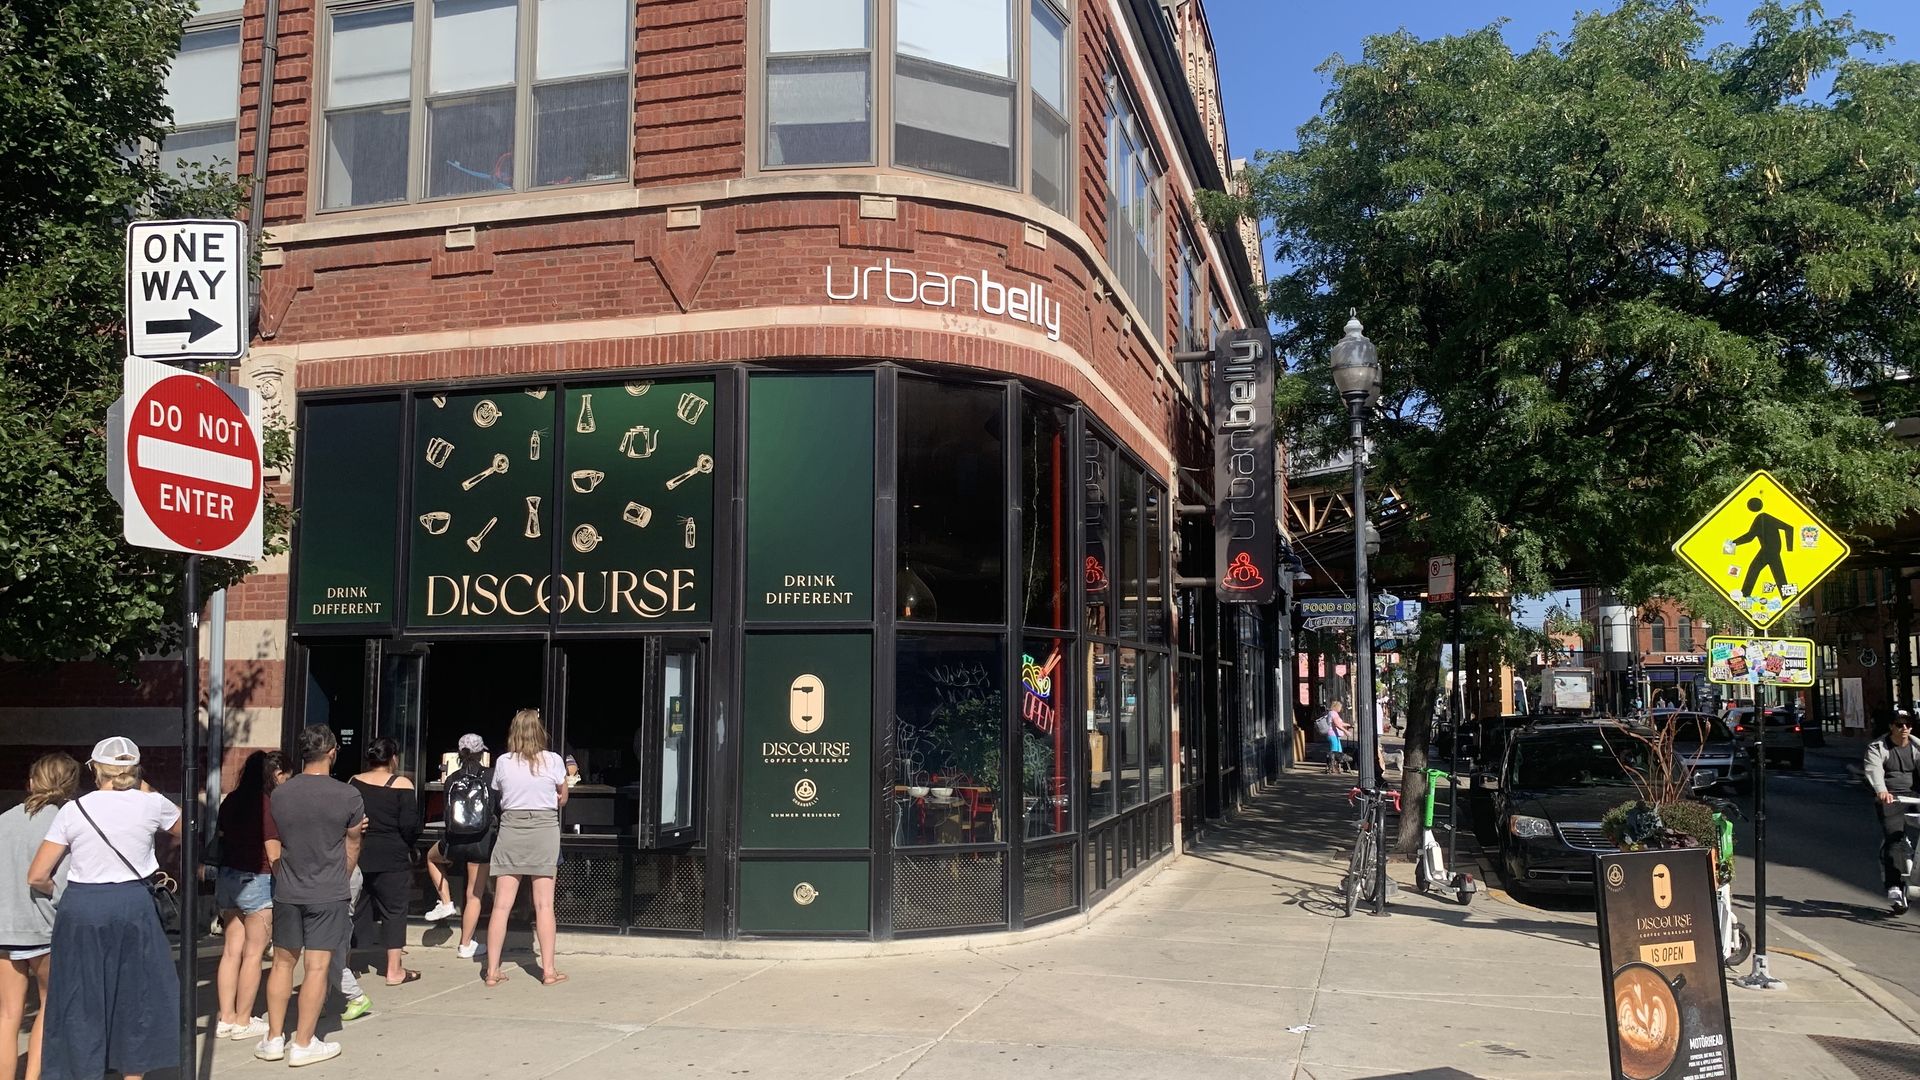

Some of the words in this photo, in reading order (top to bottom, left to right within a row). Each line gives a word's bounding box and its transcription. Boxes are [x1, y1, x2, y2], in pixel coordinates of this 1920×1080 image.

[144, 232, 225, 264] ONE
[141, 270, 226, 301] WAY
[826, 257, 1061, 342] urbanbelly
[149, 400, 182, 432] DO
[199, 412, 243, 447] NOT
[1223, 339, 1263, 541] urbanbelly
[160, 484, 234, 521] ENTER
[783, 574, 836, 587] DRINK
[327, 586, 368, 599] DRINK
[426, 569, 697, 619] DISCOURSE
[765, 592, 854, 605] DIFFERENT
[312, 602, 383, 616] DIFFERENT
[1302, 603, 1336, 612] FOOD
[1664, 655, 1699, 663] CHASE
[1023, 691, 1055, 735] OPEN
[763, 742, 850, 757] DISCOURSE
[1636, 913, 1693, 931] DISCOURSE
[1651, 948, 1660, 963] IS
[1662, 945, 1684, 961] OPEN
